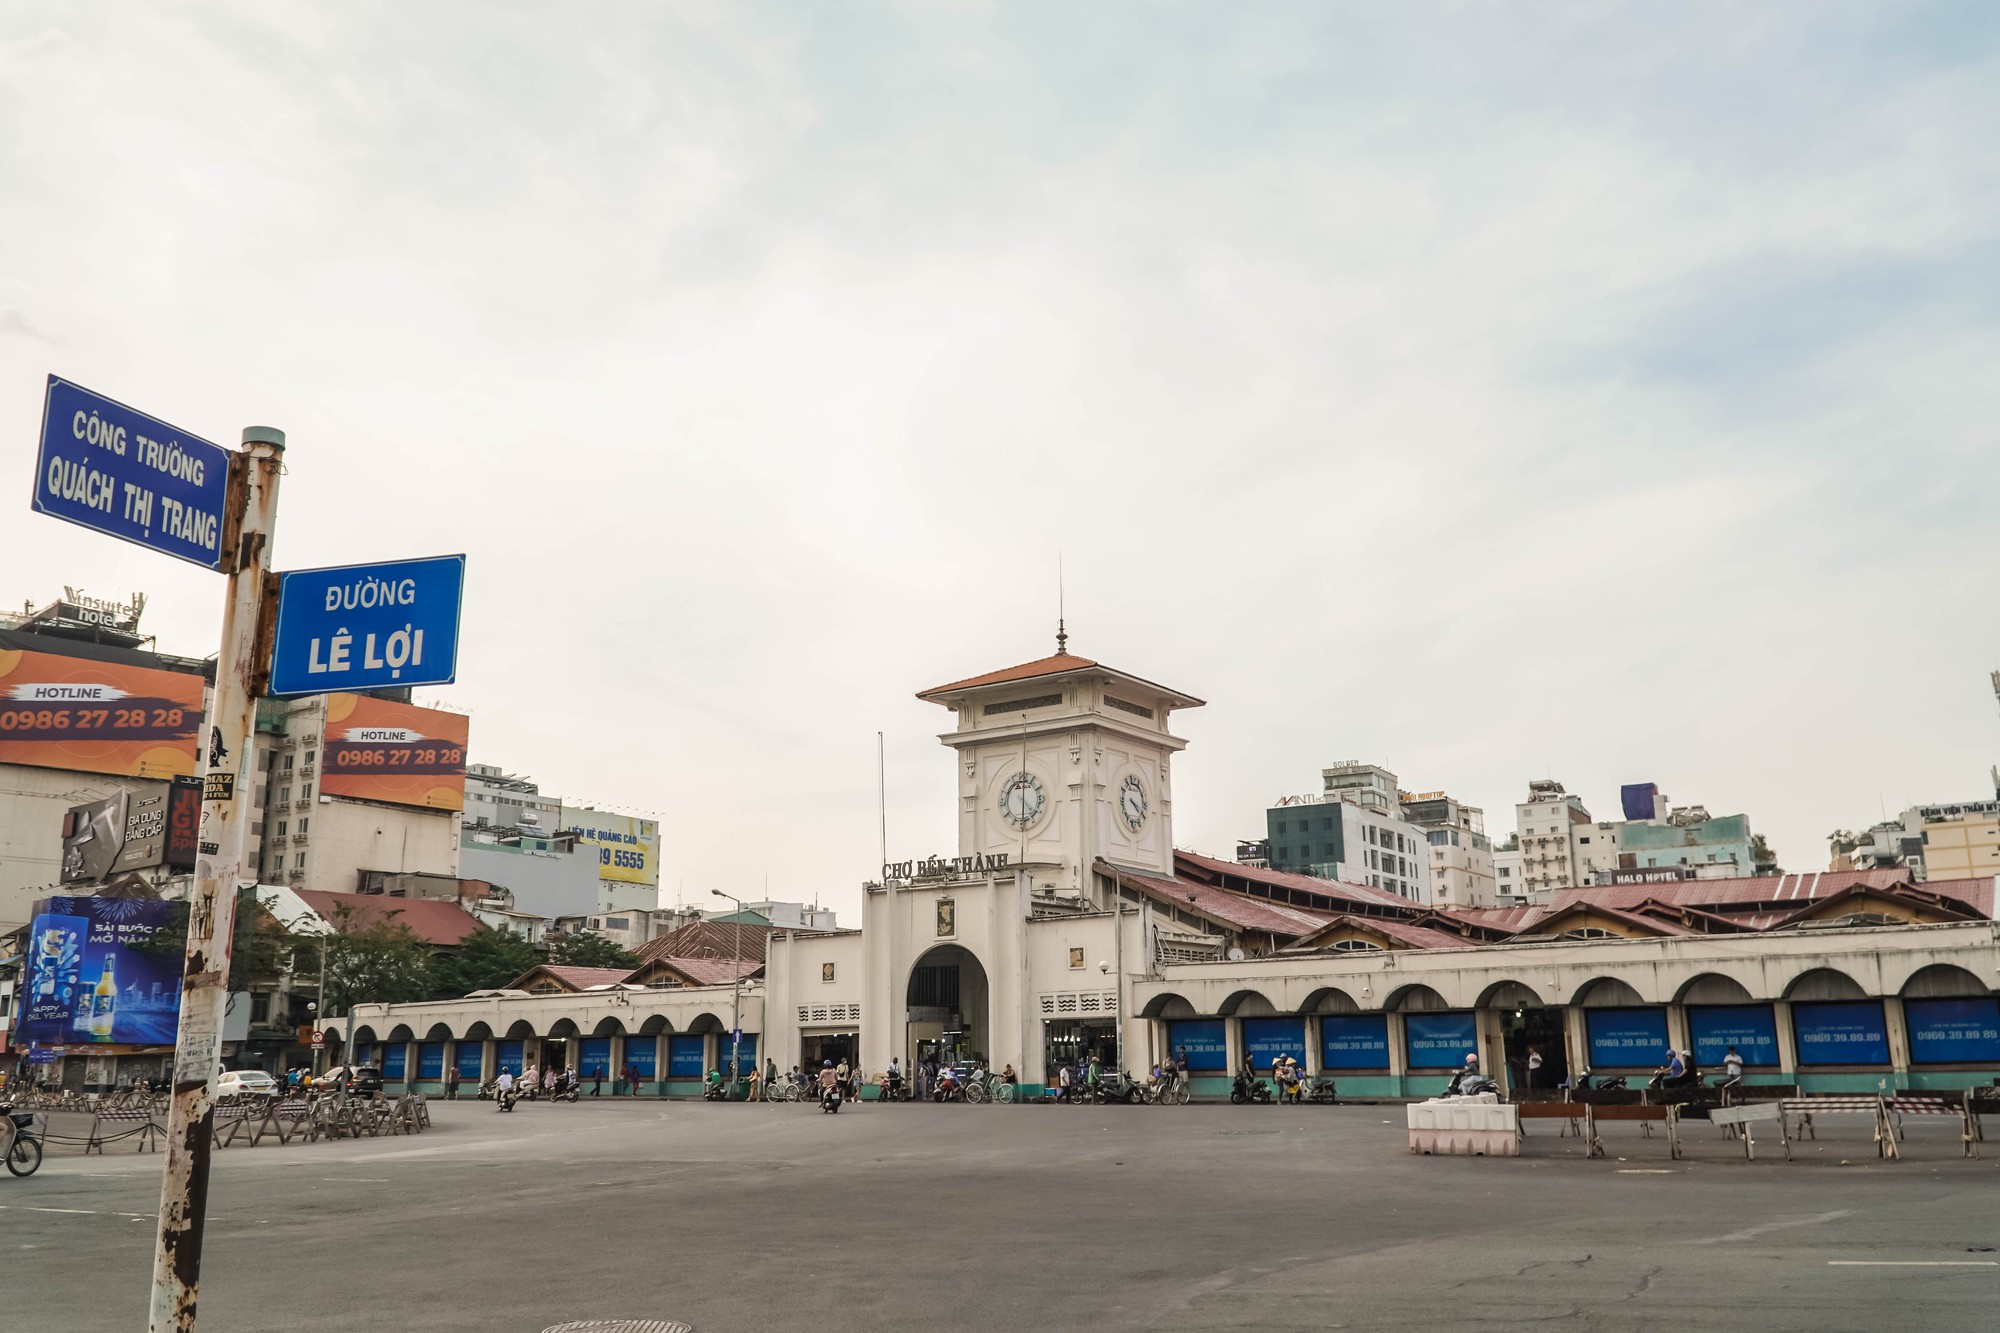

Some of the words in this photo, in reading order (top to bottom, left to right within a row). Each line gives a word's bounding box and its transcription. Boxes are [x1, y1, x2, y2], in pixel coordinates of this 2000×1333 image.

[73, 410, 126, 456] CÔNG
[136, 434, 204, 487] TRƯỜNG
[47, 455, 115, 513] QUÁCH
[124, 482, 153, 538] THỊ
[162, 496, 217, 550] TRANG
[325, 576, 415, 611] ĐƯỜNG
[78, 608, 117, 627] hotel
[308, 627, 352, 673] LÊ
[364, 623, 423, 678] LỢI
[35, 687, 102, 699] HOTLINE
[1, 710, 70, 731] 0986
[75, 709, 109, 729] 27
[113, 708, 146, 728] 28
[151, 708, 183, 727] 28
[360, 731, 406, 741] HOTLINE
[337, 750, 385, 766] 0986
[388, 749, 411, 765] 27
[414, 749, 436, 764] 28
[440, 749, 461, 764] 28
[128, 815, 140, 826] GIA
[587, 827, 596, 841] HỆ
[598, 828, 621, 842] QUẢNG
[624, 833, 637, 845] CÁO
[614, 850, 644, 870] 5555
[882, 859, 913, 880] CHỢ
[917, 854, 946, 876] BẾN
[952, 851, 1009, 874] THÀNH
[1617, 874, 1643, 885] HALO
[1645, 872, 1678, 883] HOTEL
[95, 922, 115, 932] SẢI
[89, 934, 113, 943] MỞ
[44, 1012, 68, 1020] YEAR
